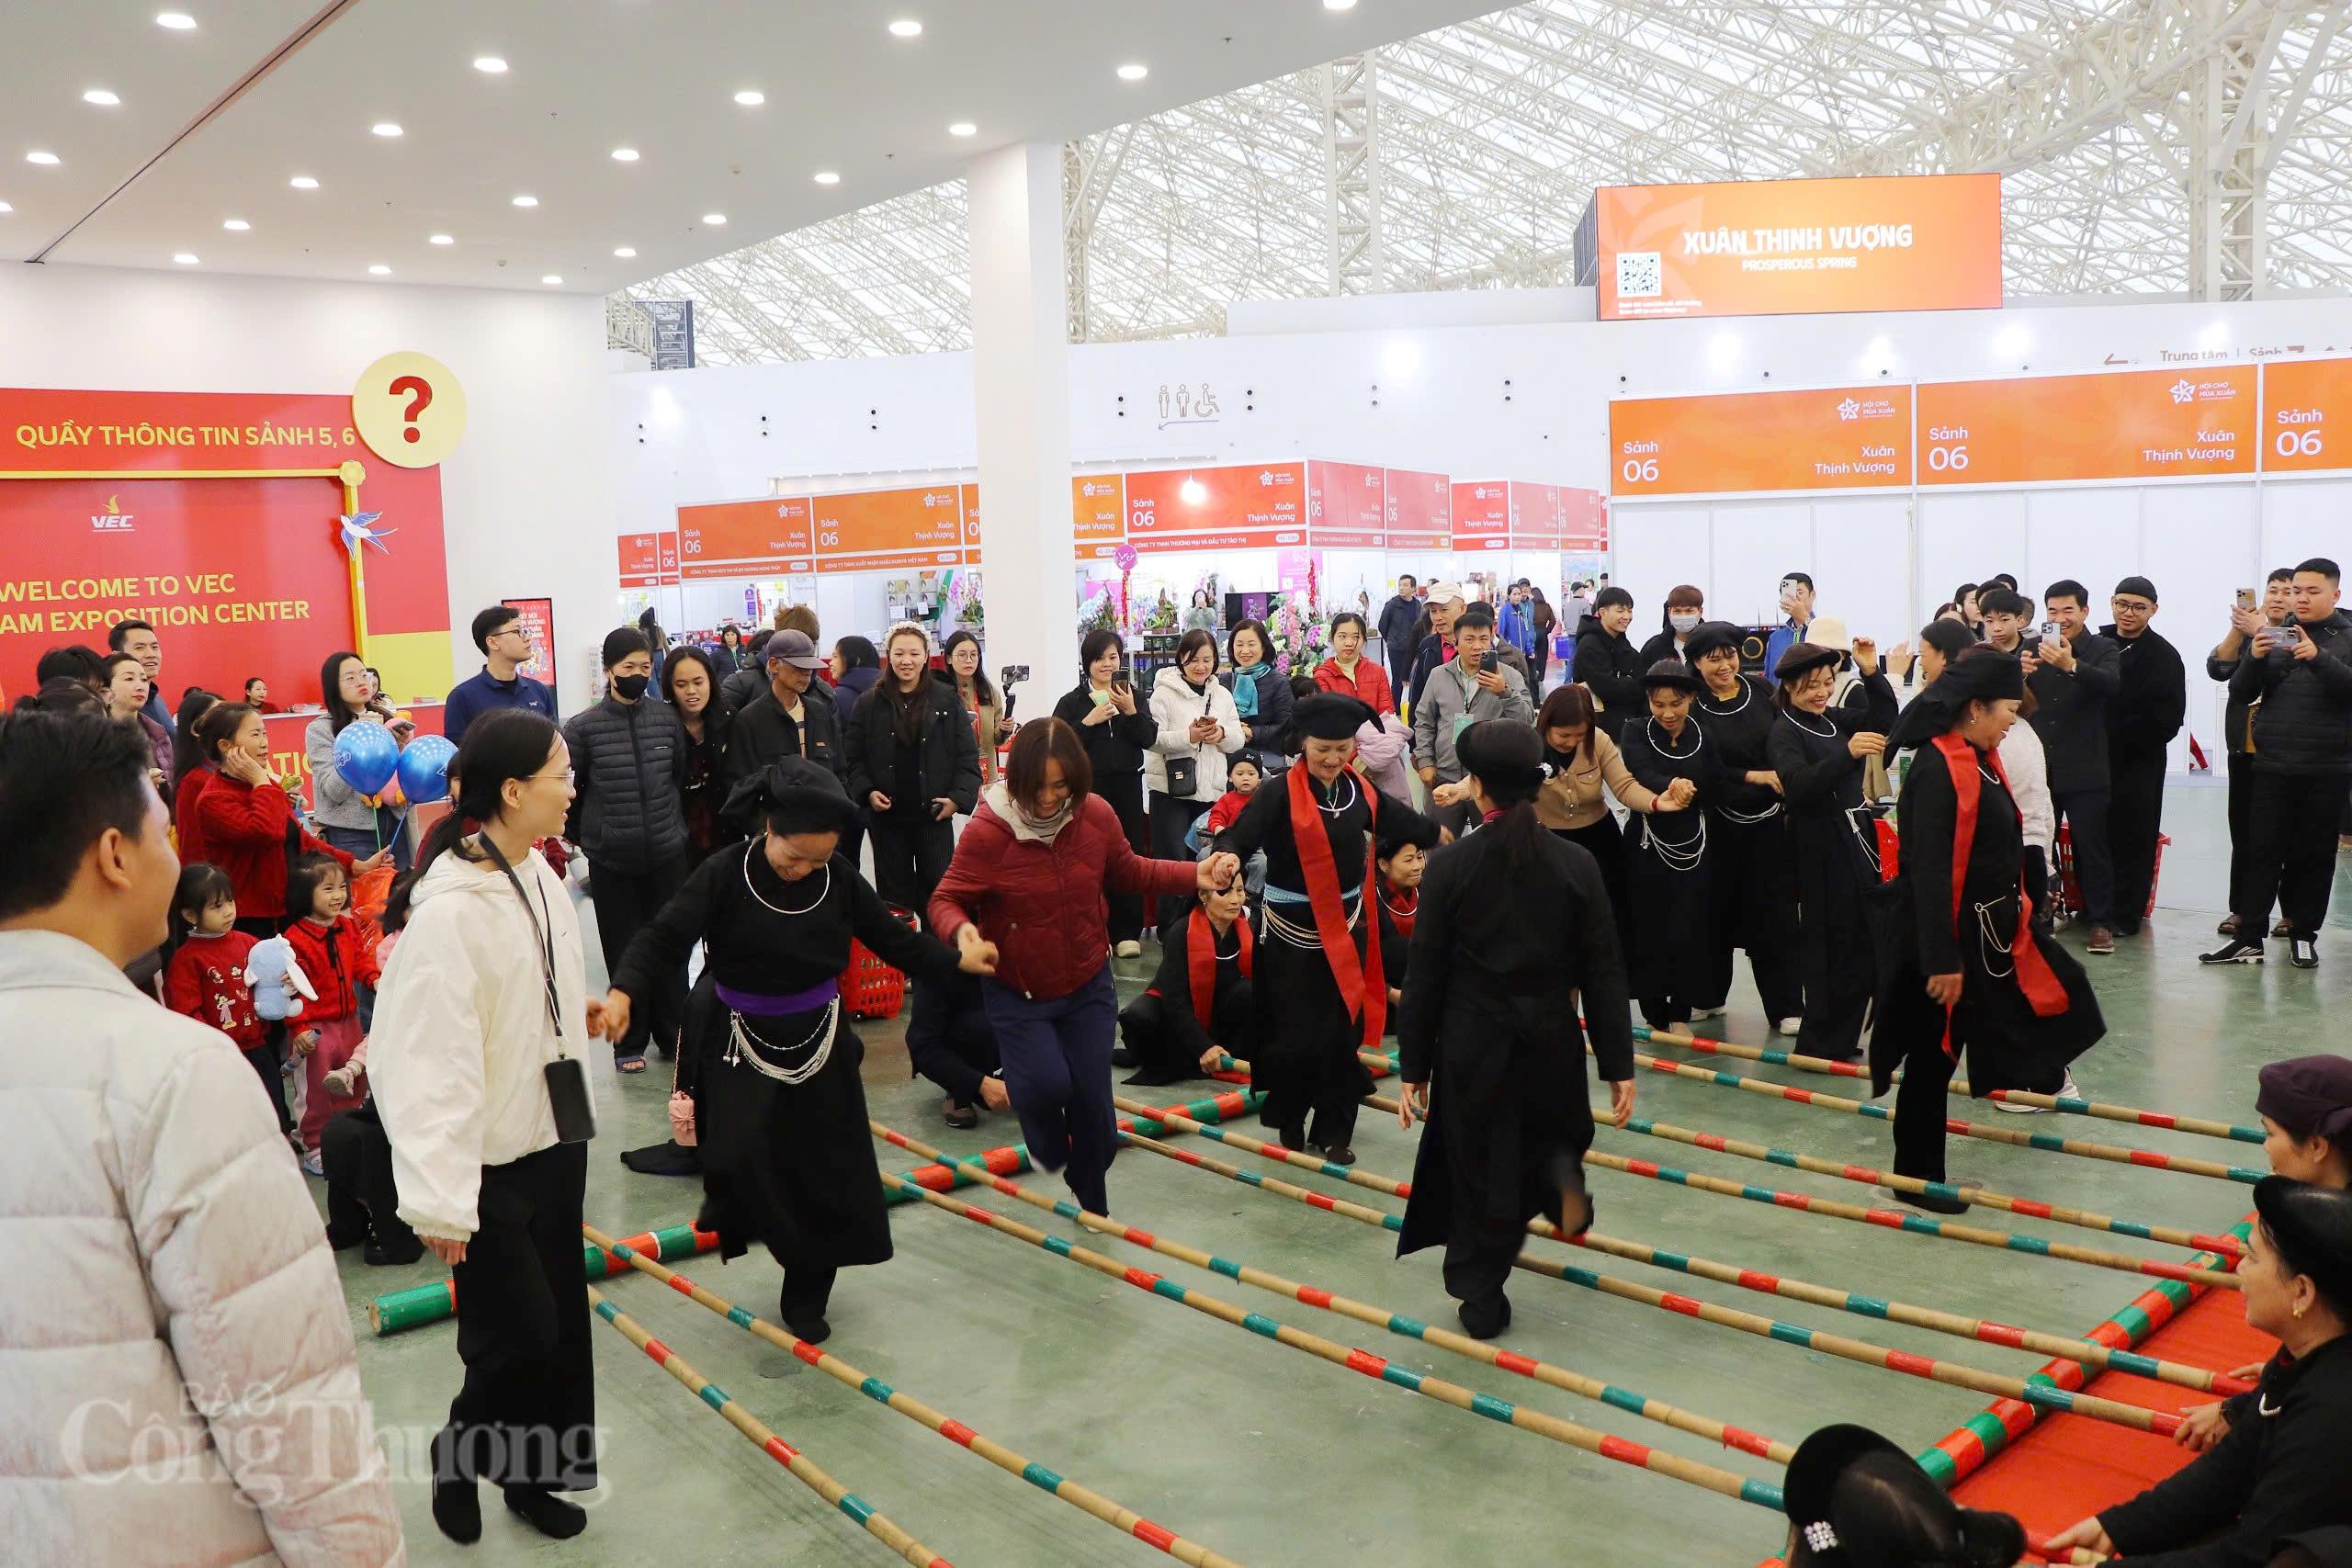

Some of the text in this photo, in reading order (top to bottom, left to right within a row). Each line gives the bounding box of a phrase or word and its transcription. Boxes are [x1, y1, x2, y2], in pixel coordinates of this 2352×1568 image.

[1683, 223, 1913, 254] XUÂN THỊNH VƯỢNG
[1742, 256, 1857, 272] PROSPEROUS SPRING
[2278, 408, 2323, 424] Sảnh
[17, 419, 93, 449] QUẦY
[99, 422, 196, 446] THÔNG
[198, 425, 240, 446] TIN
[245, 421, 314, 446] SẢNH
[342, 426, 356, 446] 6
[1929, 426, 1968, 441] Sảnh
[2197, 429, 2234, 443] Xuân
[1623, 440, 1659, 455] Sảnh
[2276, 429, 2323, 456] 06
[1861, 445, 1895, 457] Xuân
[1928, 446, 1968, 470] 06
[2143, 447, 2234, 463] Thịnh Vượng
[1623, 459, 1659, 482] 06
[1815, 461, 1895, 476] Thịnh Vượng
[1133, 499, 1154, 508] Sảnh
[1274, 502, 1295, 511] Xuân
[1311, 501, 1322, 516] 06
[91, 515, 134, 528] VEC
[820, 519, 838, 527] Sảnh
[1133, 511, 1155, 526] 06
[1247, 513, 1295, 523] Thịnh Vượng
[790, 531, 806, 539] Xuân
[820, 532, 839, 546] 06
[684, 540, 701, 554] 06
[662, 557, 675, 567] 06
[0, 573, 236, 602] WELCOME TO VEC
[50, 604, 209, 632] EXPOSITION
[215, 600, 311, 624] CENTER
